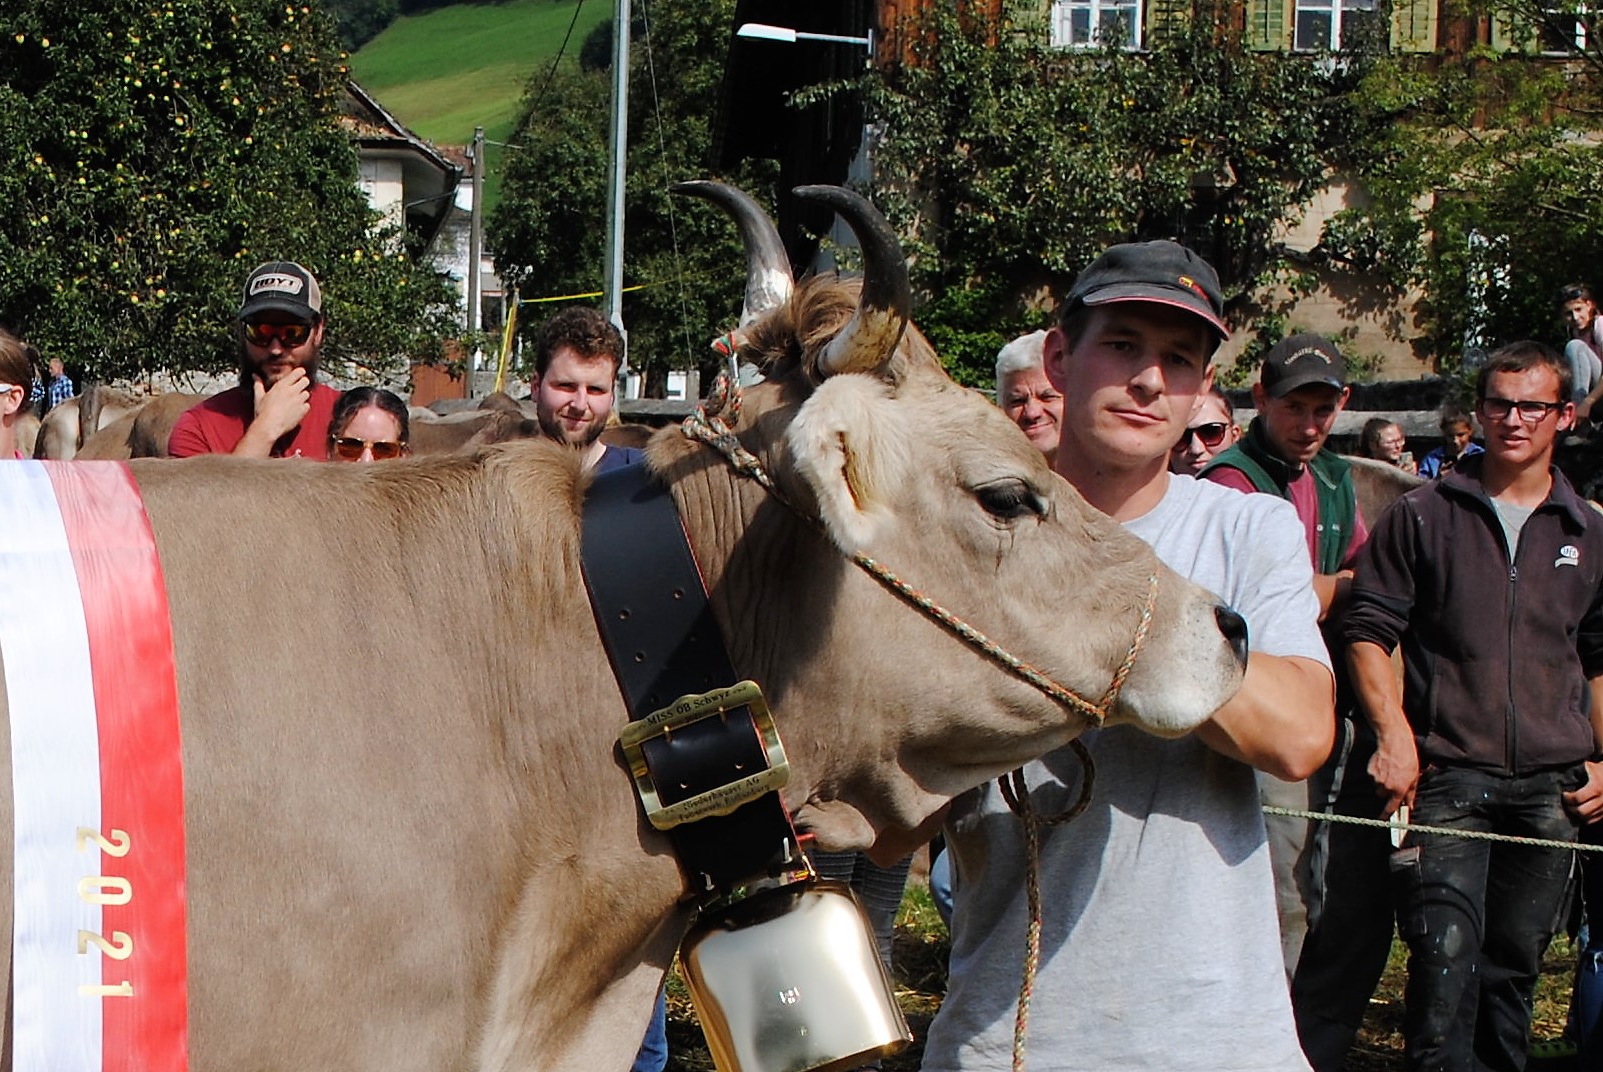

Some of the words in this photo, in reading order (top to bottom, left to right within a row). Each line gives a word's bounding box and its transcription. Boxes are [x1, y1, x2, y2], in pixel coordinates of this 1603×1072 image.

[646, 711, 674, 725] MISS
[694, 690, 730, 709] Schwyz
[77, 826, 134, 997] 2021
